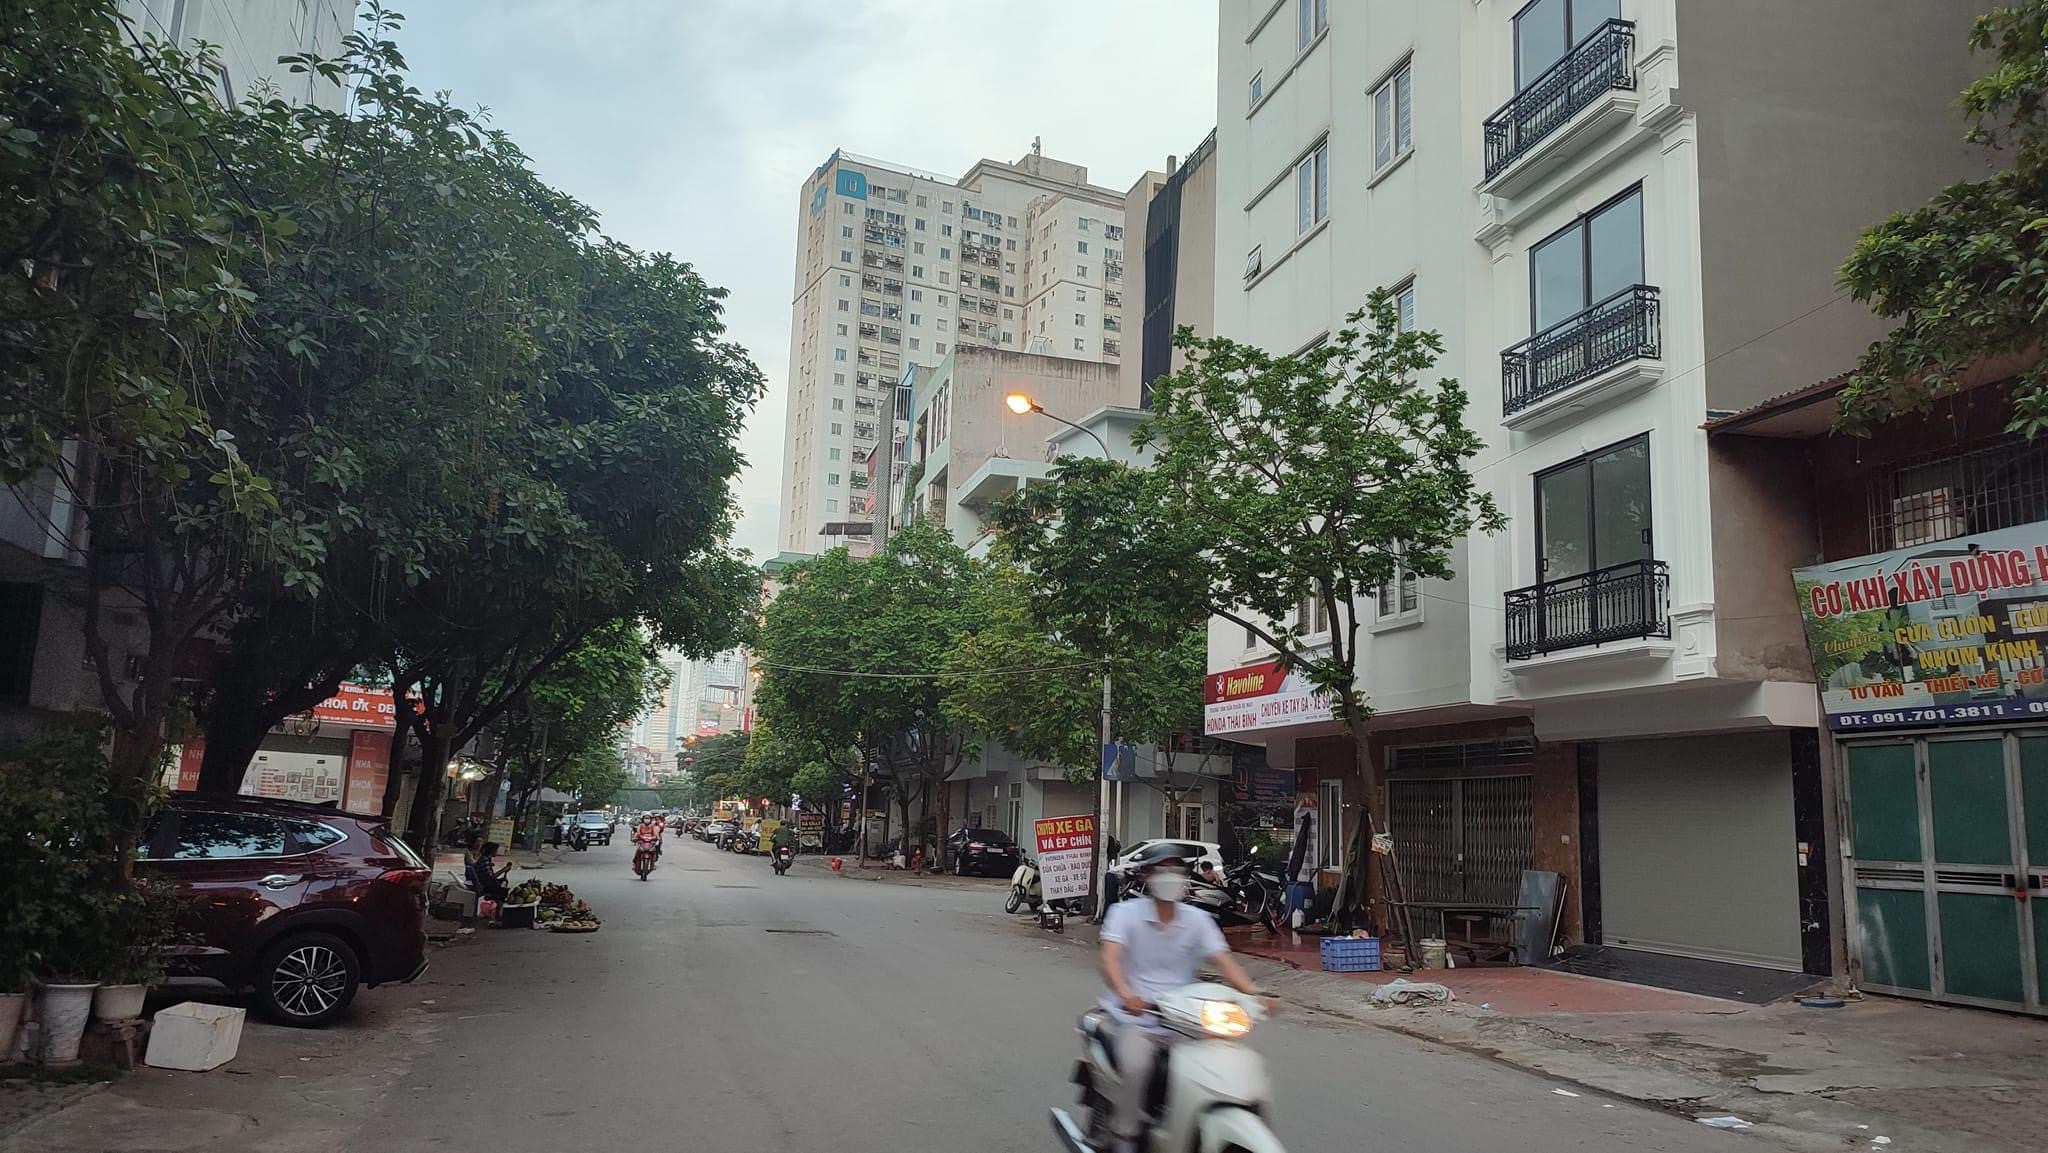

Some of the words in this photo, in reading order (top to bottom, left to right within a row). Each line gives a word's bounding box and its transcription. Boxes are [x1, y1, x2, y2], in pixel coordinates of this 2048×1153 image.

[1812, 582, 1841, 617] CƠ
[1848, 570, 1890, 611] KHÍ
[1893, 563, 1943, 604] XÂY
[1950, 550, 2031, 599] DỰNG
[1227, 673, 1265, 696] Havoline
[1872, 704, 2004, 723] 091.701.3811
[1056, 821, 1073, 834] XE
[1075, 818, 1094, 832] GA
